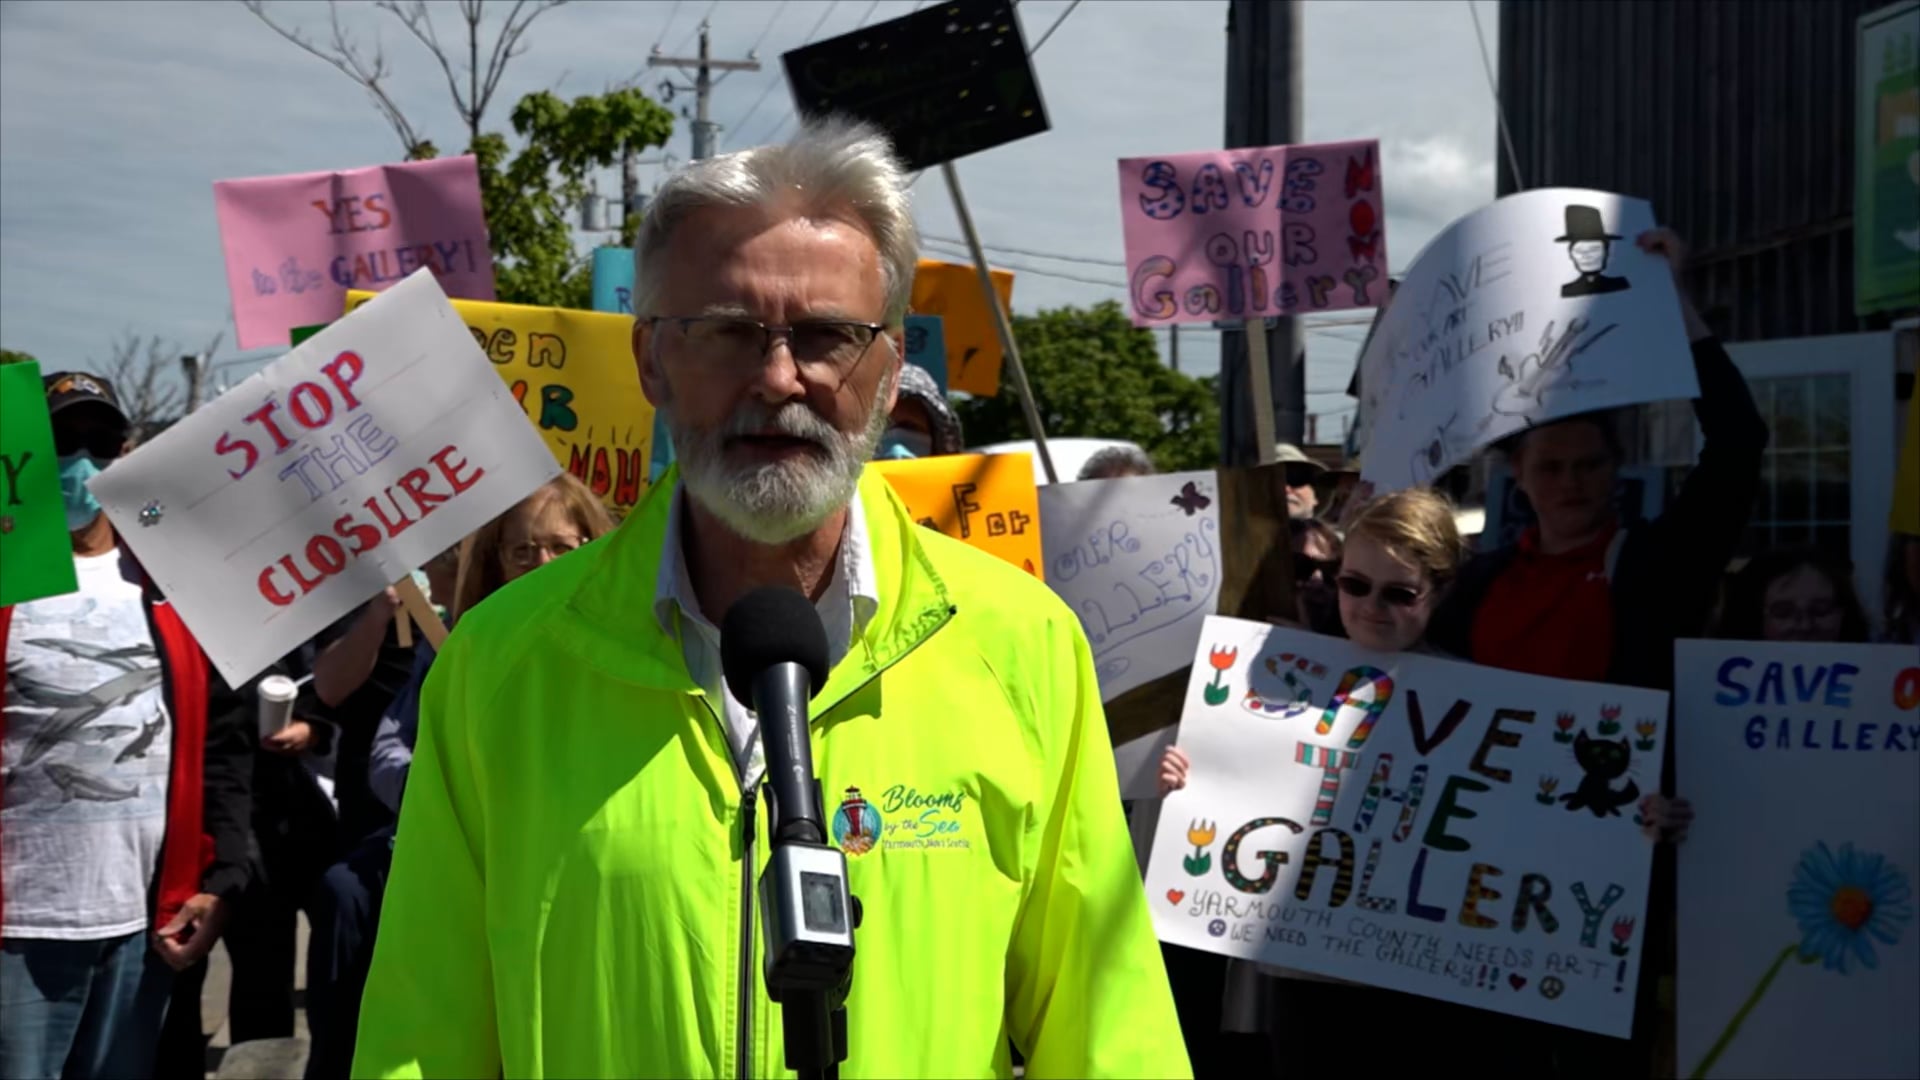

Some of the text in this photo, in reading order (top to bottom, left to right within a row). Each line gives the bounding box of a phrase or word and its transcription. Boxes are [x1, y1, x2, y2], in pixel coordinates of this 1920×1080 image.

[311, 192, 392, 236] YES
[1139, 157, 1325, 221] SAVE
[1344, 146, 1381, 264] NOW
[1205, 221, 1319, 267] OUR
[214, 350, 365, 481] STOP
[278, 412, 399, 502] THE
[257, 444, 486, 607] CLOSURE
[1054, 519, 1141, 582] OUR
[1241, 652, 1537, 784] SAVE
[1714, 656, 1860, 708] SAVE
[882, 784, 966, 813] Blooms
[901, 819, 918, 830] the
[915, 809, 960, 839] Sea
[1295, 741, 1491, 852] THE
[1221, 816, 1626, 948] GALLERY
[1188, 888, 1334, 929] YARMOUTH
[1348, 916, 1442, 959] COUNTY
[1454, 941, 1534, 969] NEEDS
[1229, 924, 1256, 942] WE
[1264, 926, 1308, 946] NEED
[1320, 934, 1364, 957] THE
